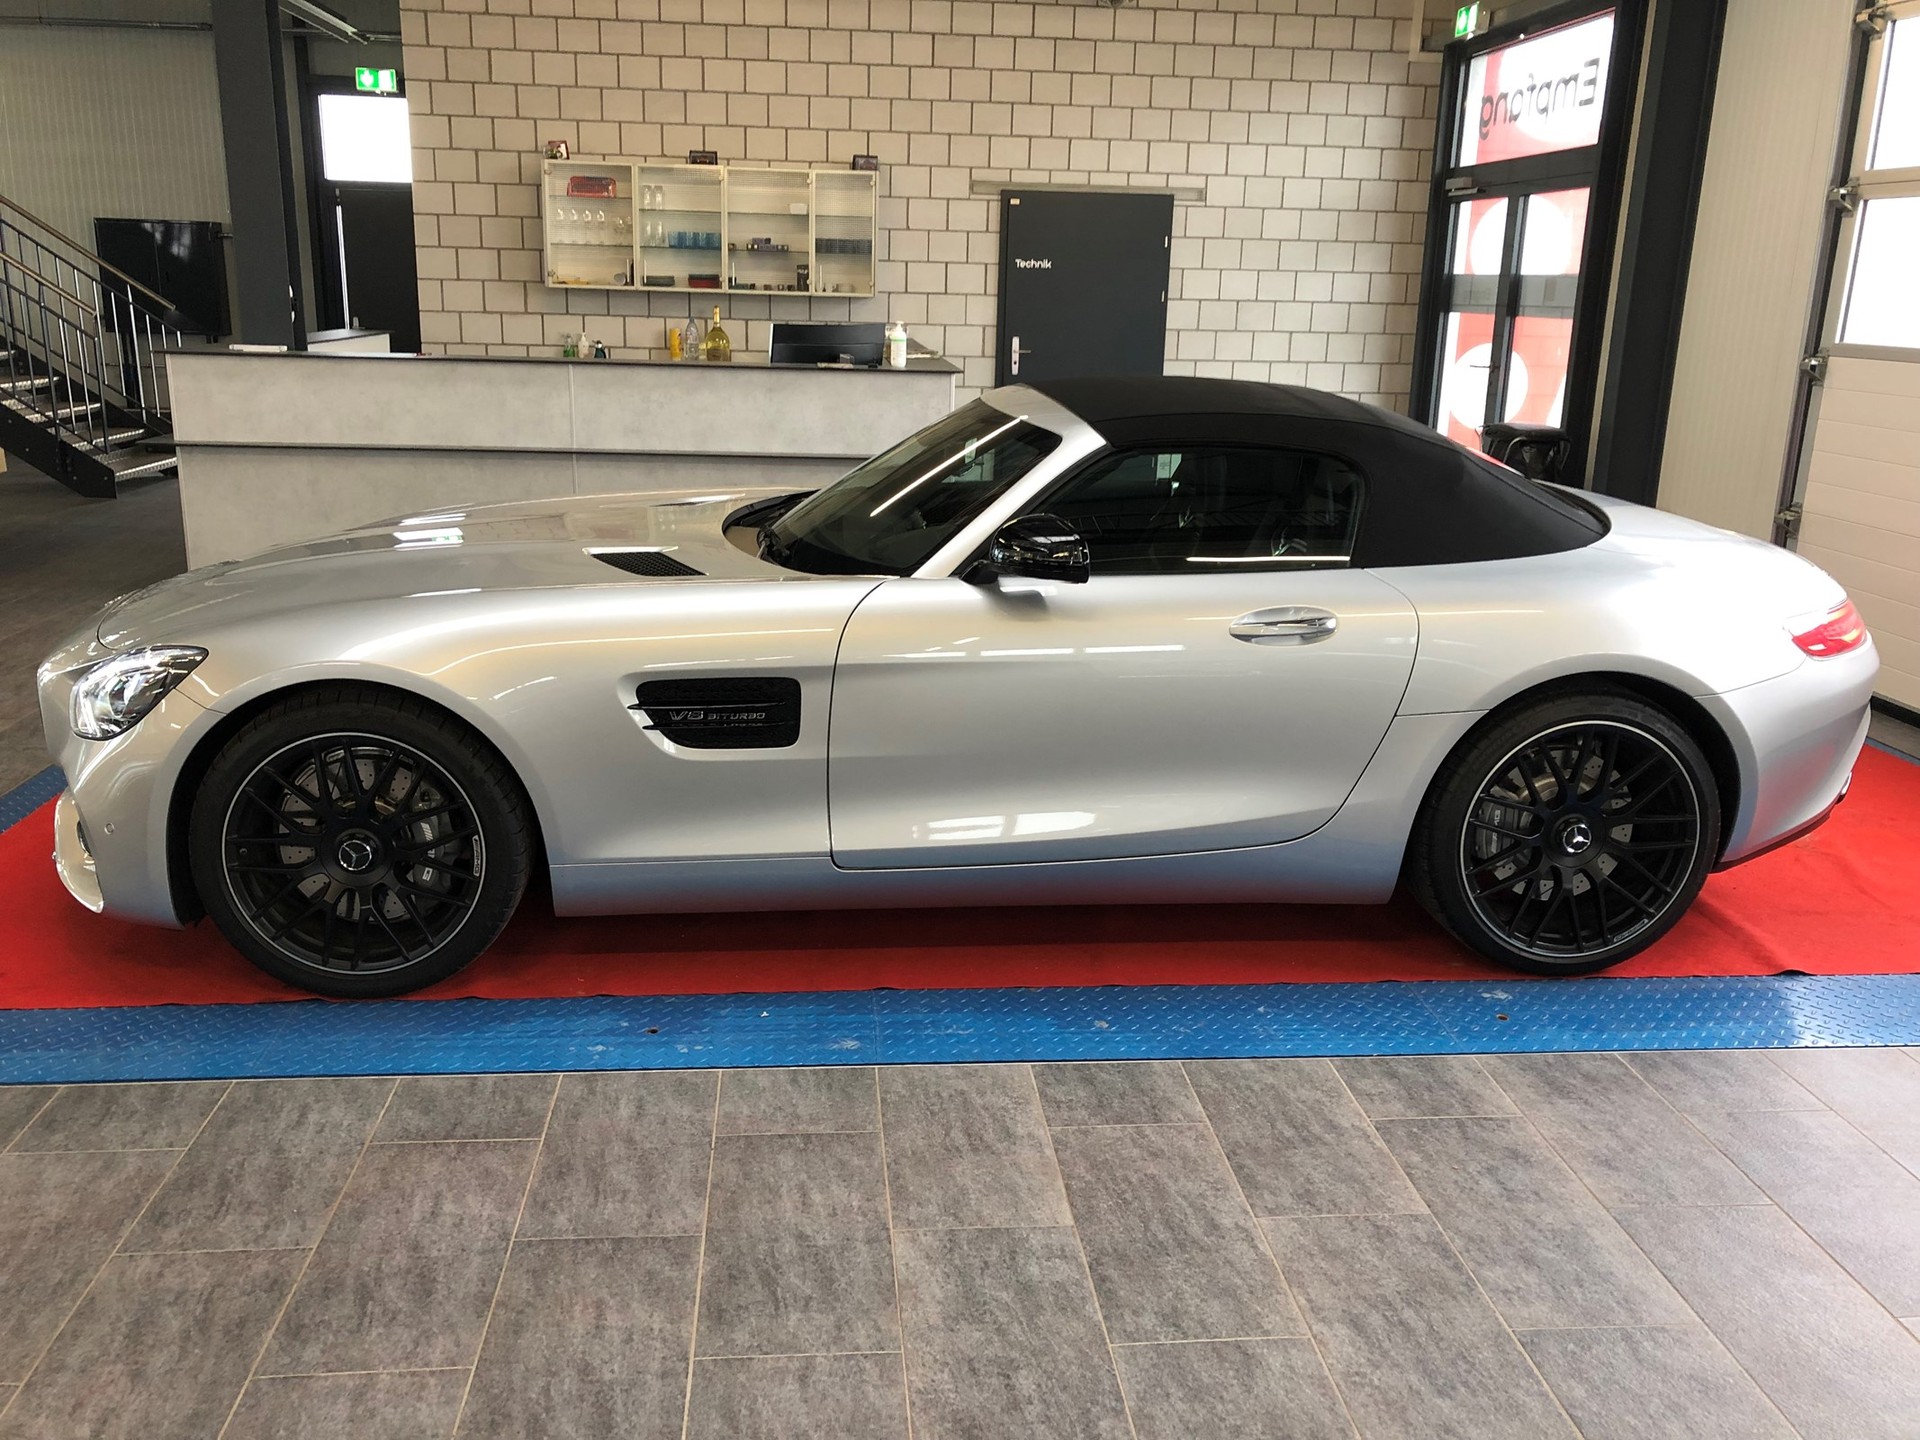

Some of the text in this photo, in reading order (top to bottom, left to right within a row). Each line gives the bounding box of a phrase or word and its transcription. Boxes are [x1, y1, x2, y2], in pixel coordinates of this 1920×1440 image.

[1014, 258, 1052, 269] Technik
[669, 710, 766, 720] V8 BITURBO
